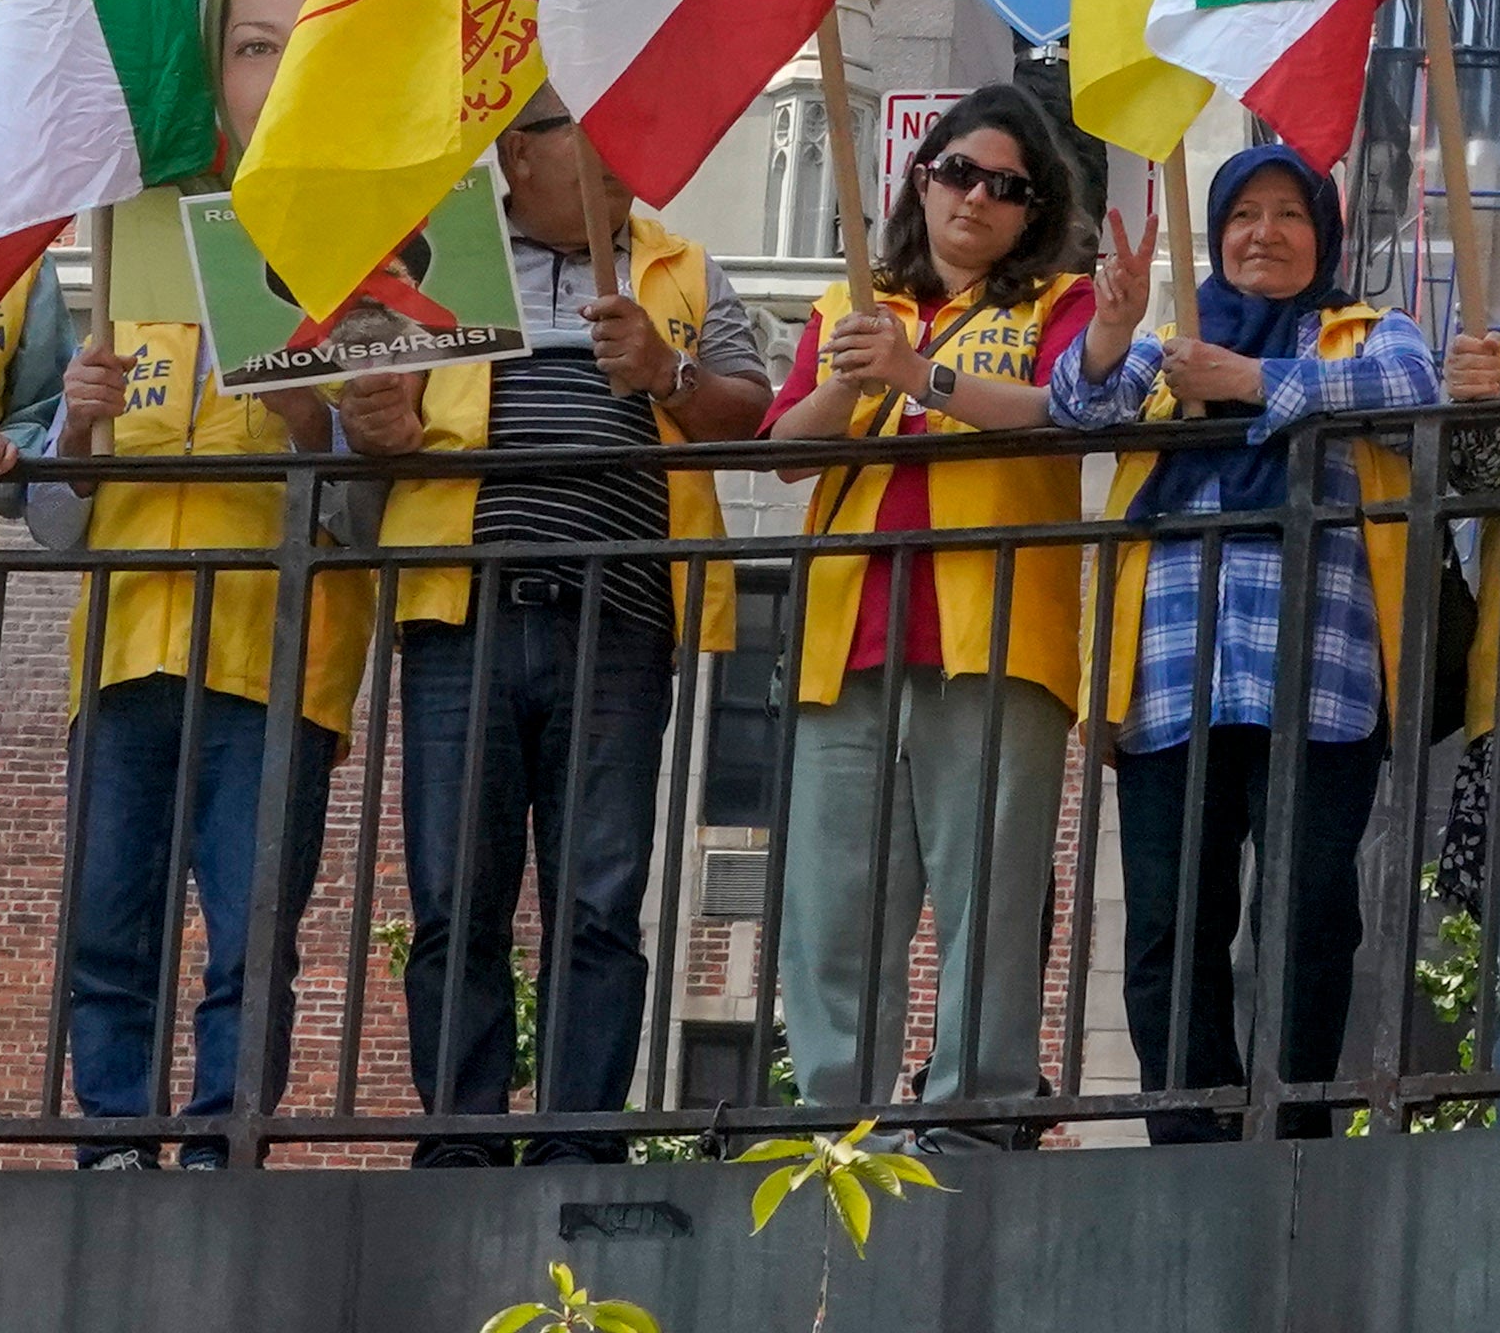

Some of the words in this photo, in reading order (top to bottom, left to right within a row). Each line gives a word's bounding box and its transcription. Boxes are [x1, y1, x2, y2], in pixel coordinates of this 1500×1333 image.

[242, 325, 498, 374] #NoVisa4Raisi
[955, 350, 1036, 383] IRAN
[125, 385, 167, 414] AN
